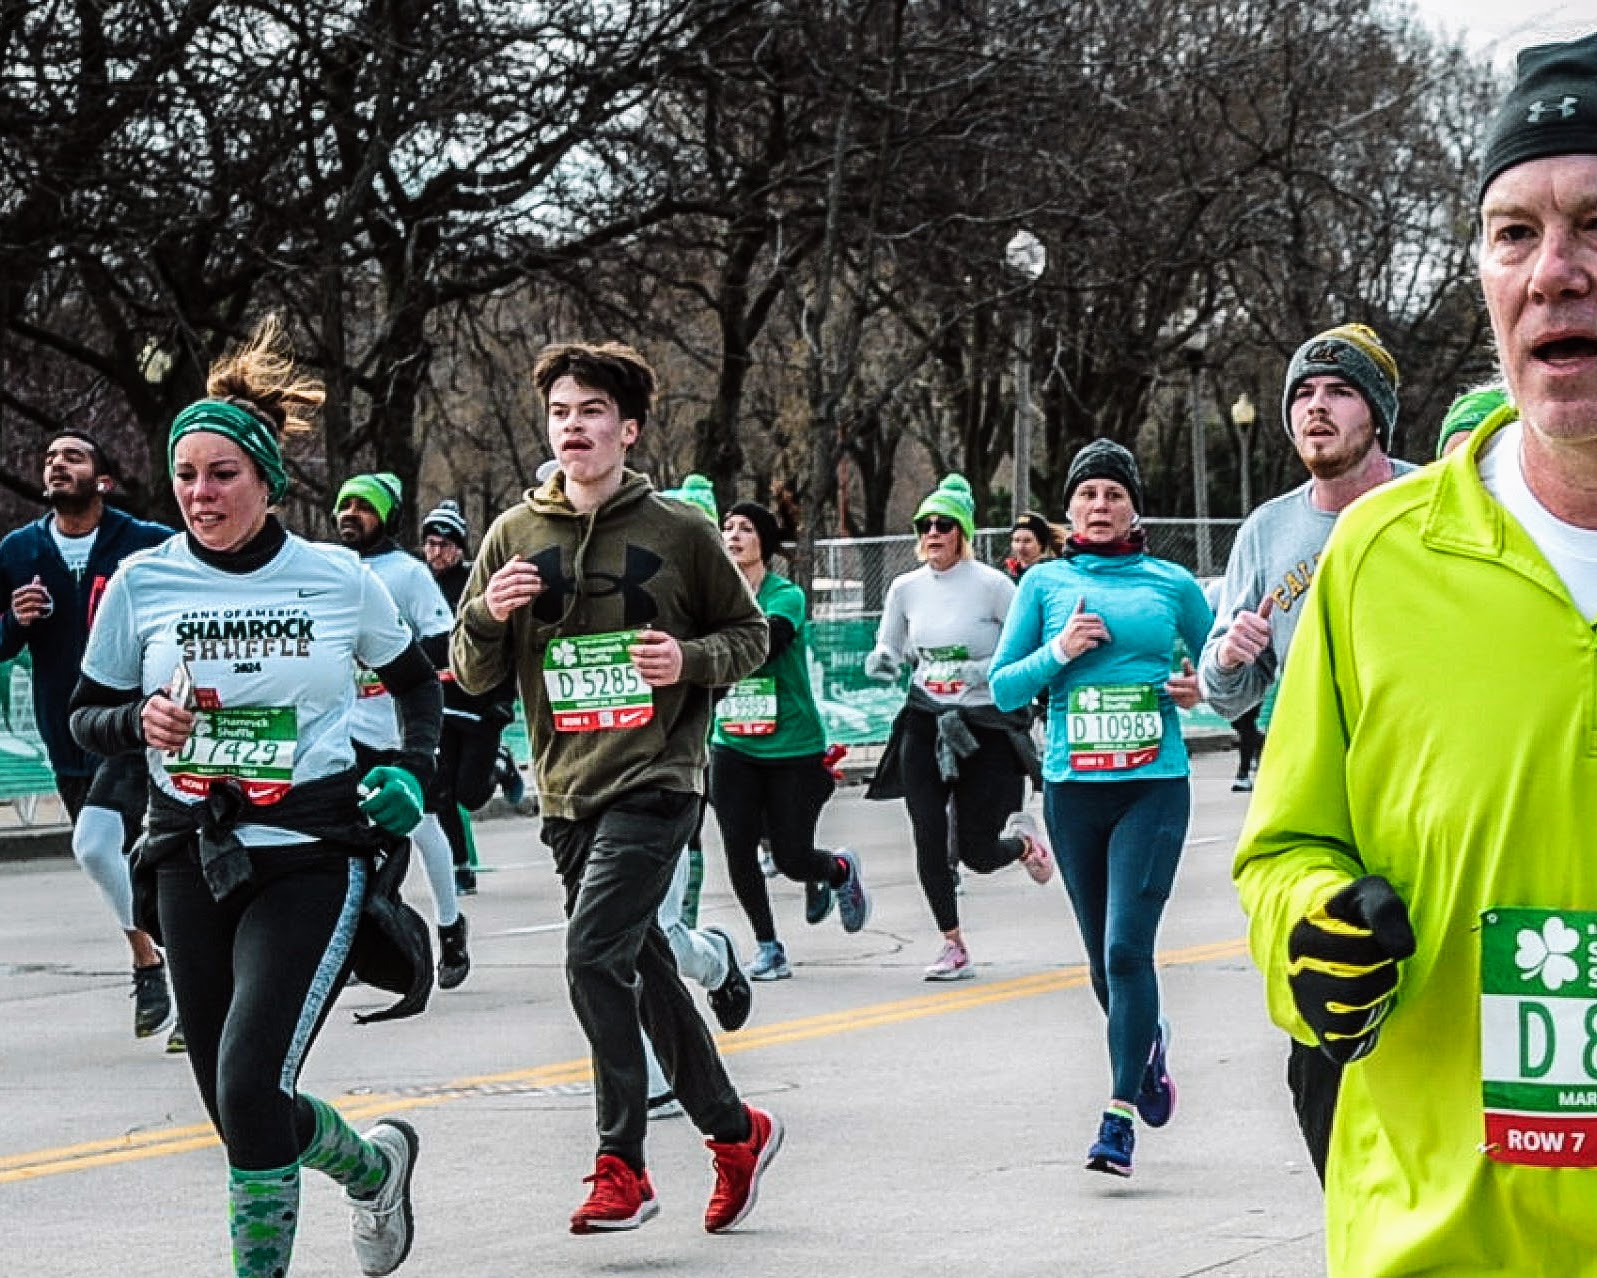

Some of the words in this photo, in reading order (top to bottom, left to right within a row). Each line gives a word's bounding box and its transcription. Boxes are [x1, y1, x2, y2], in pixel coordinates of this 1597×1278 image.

[176, 618, 315, 646] SHAMROCK
[183, 636, 310, 662] SHUFFLE
[558, 672, 574, 698] D
[582, 666, 638, 696] 5285
[1073, 715, 1087, 742] D
[1095, 713, 1157, 740] 10983
[208, 738, 279, 766] 7429
[1517, 1000, 1556, 1079] D
[1506, 1128, 1565, 1152] ROW
[1570, 1132, 1586, 1153] 7
